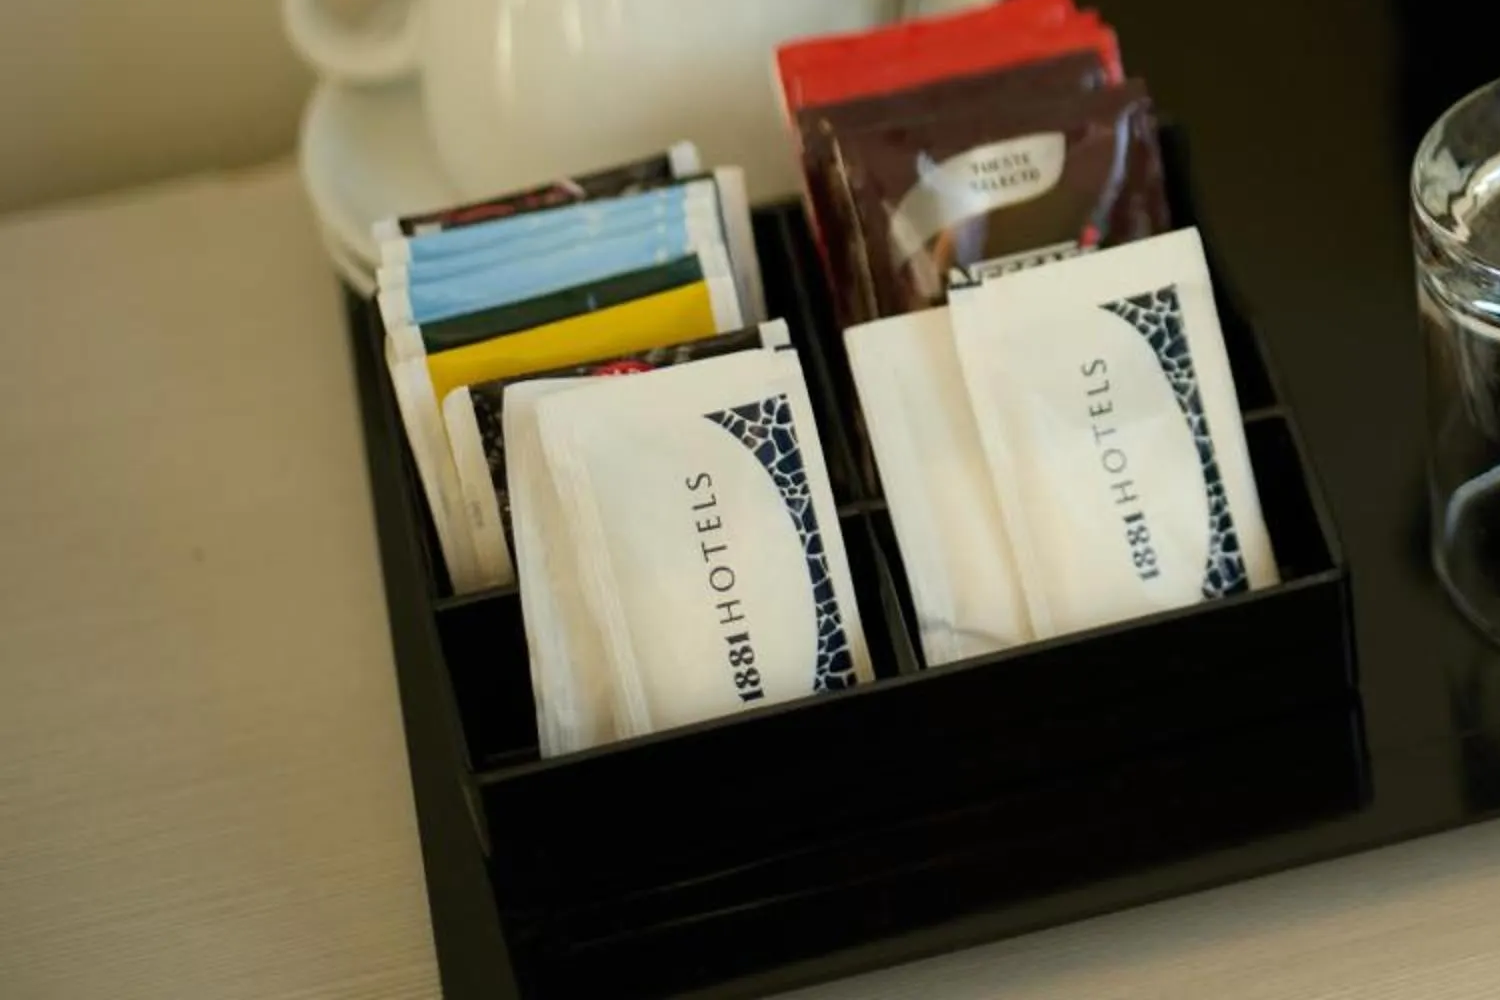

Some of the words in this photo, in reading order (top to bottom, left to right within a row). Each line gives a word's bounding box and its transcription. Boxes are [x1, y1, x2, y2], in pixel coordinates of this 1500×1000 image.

[1081, 358, 1139, 504] HOTELS
[685, 471, 745, 624] HOTELS
[1122, 511, 1160, 581] 1881
[725, 631, 765, 702] 1881
